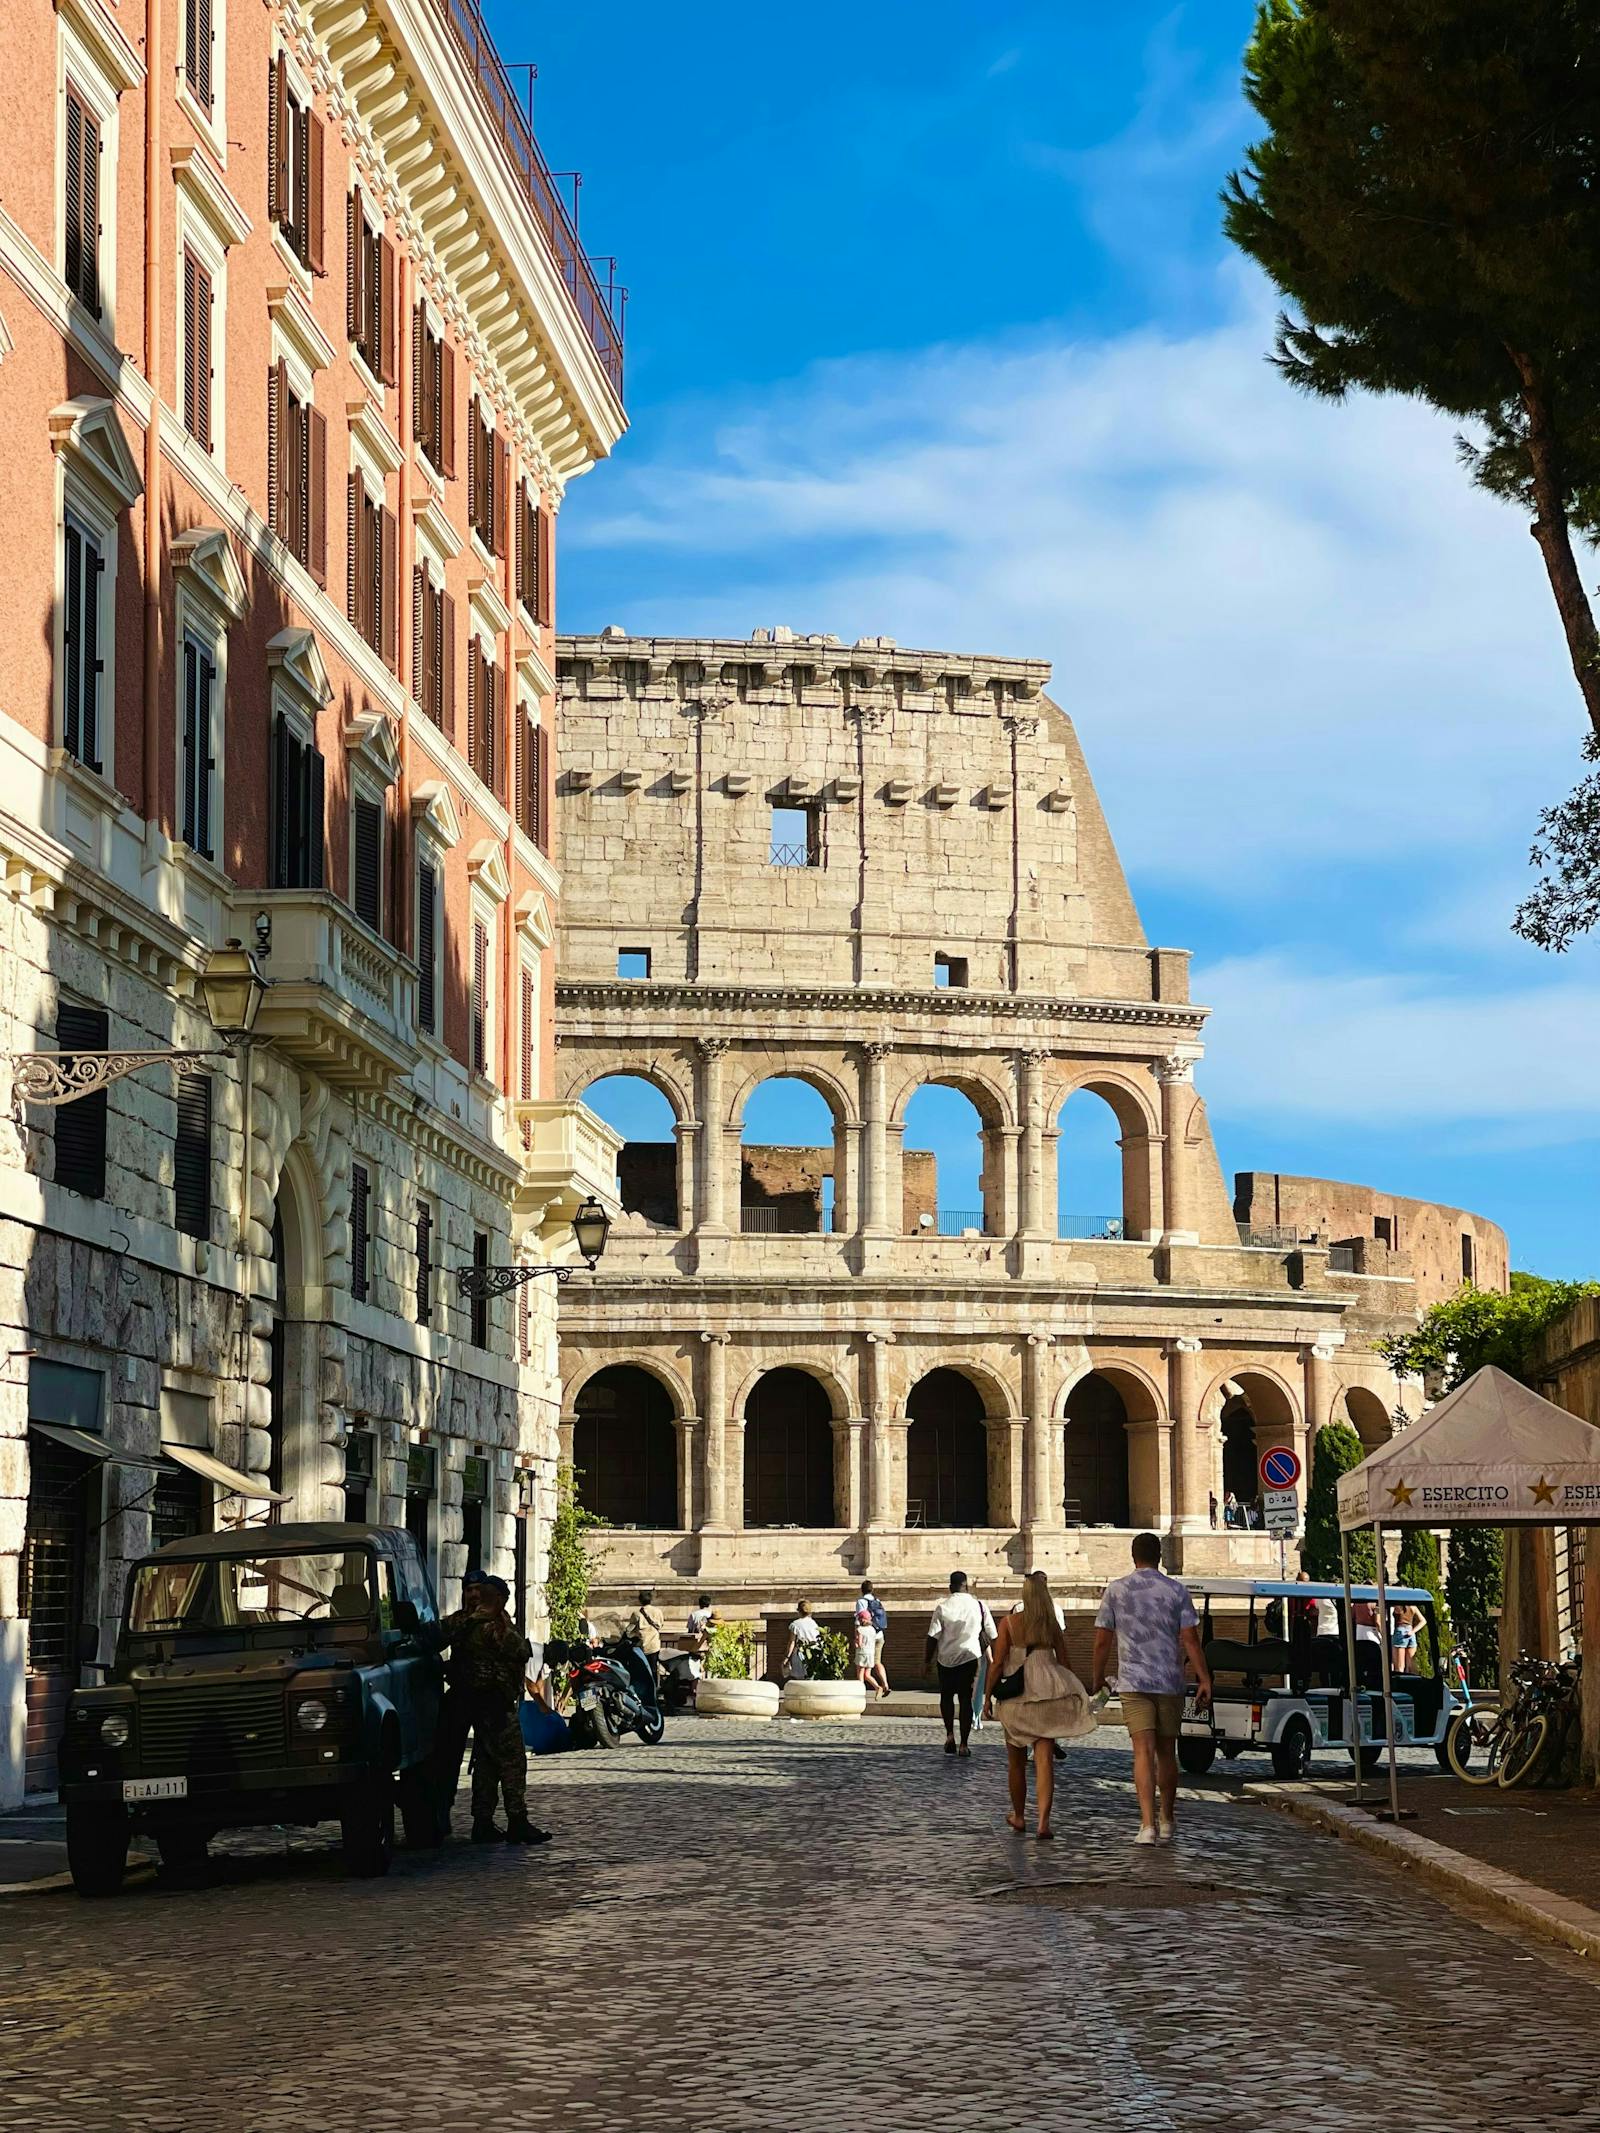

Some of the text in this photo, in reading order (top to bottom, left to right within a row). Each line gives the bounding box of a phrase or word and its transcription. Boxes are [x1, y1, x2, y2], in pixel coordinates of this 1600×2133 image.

[1281, 1495, 1292, 1503] 24
[1422, 1486, 1508, 1501] ESERCITO
[145, 1784, 159, 1797] AJ
[166, 1783, 184, 1794] 111
